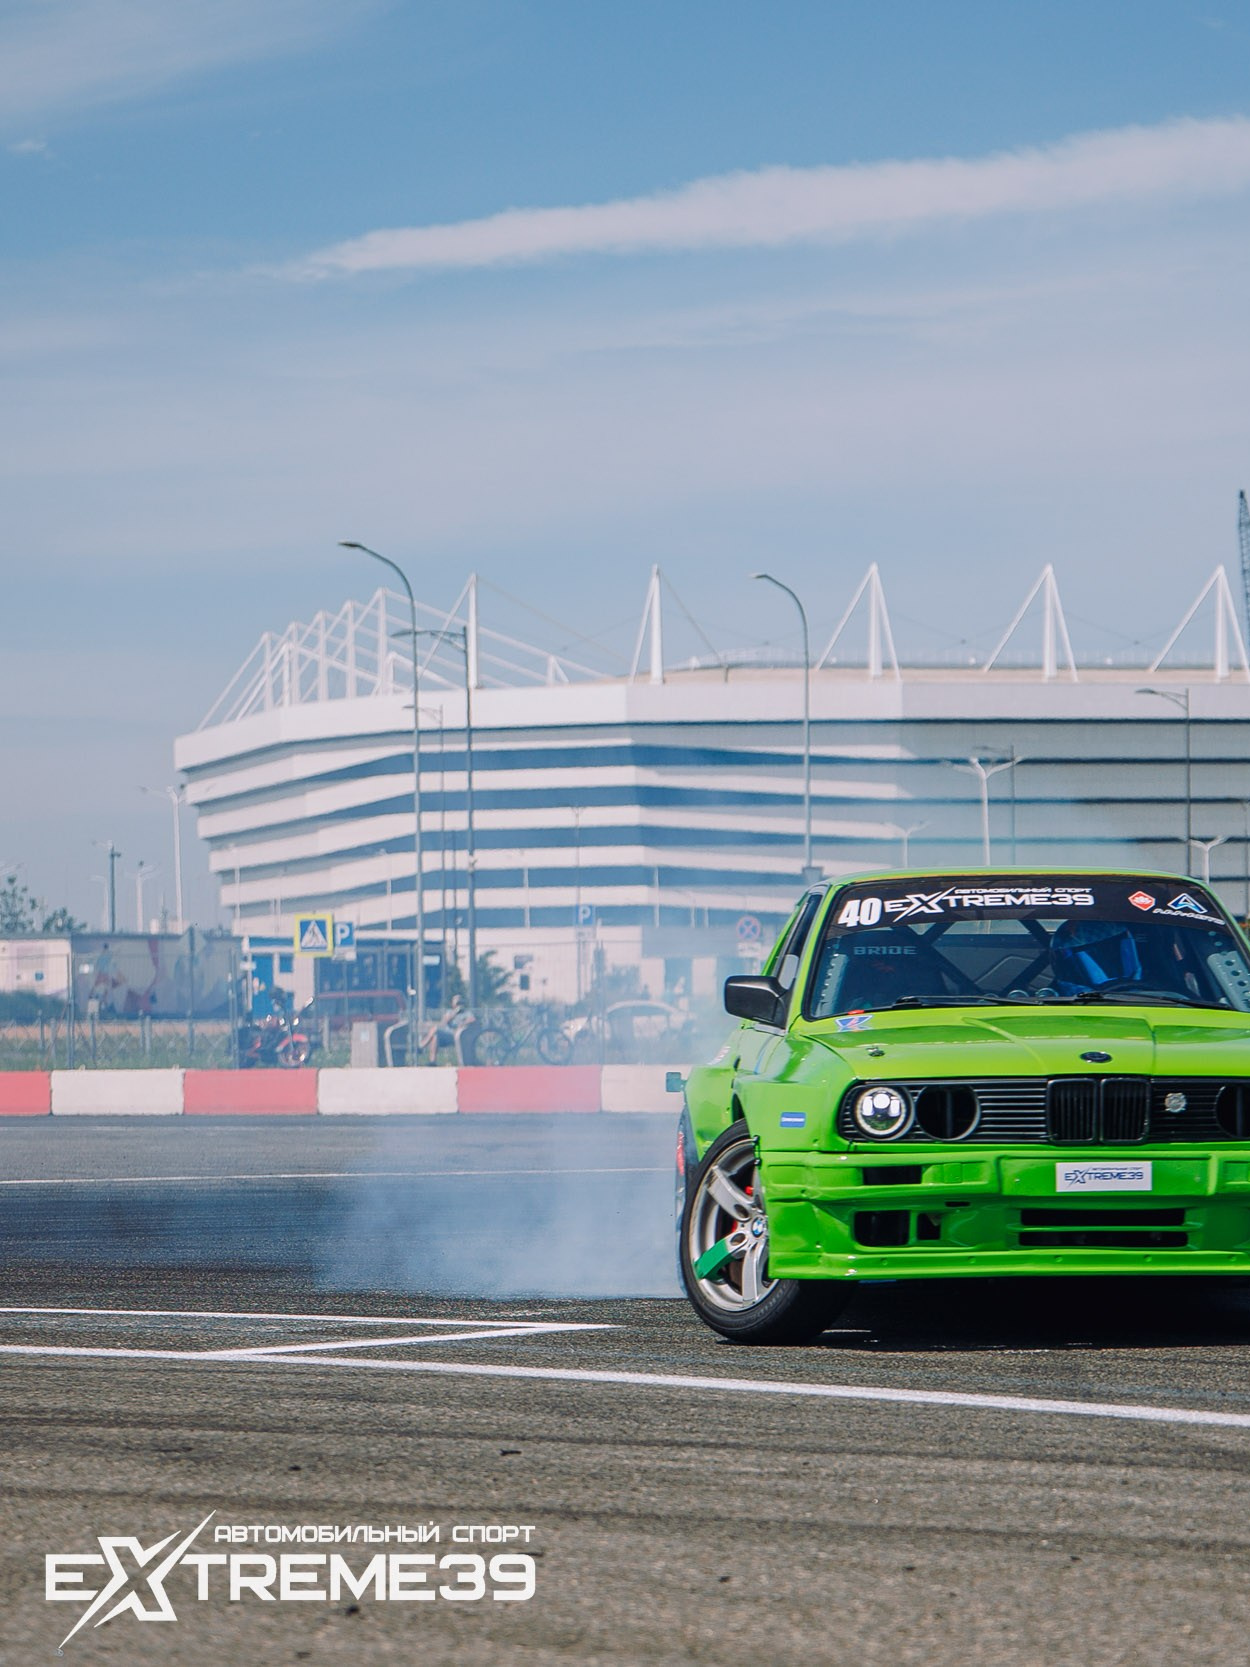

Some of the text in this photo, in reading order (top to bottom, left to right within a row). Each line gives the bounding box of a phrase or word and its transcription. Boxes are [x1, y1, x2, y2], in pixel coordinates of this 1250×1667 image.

[837, 886, 1095, 928] 40 EXTREME39
[335, 922, 350, 946] P
[852, 945, 918, 956] BRIDE
[1064, 1167, 1144, 1188] EXTREME39
